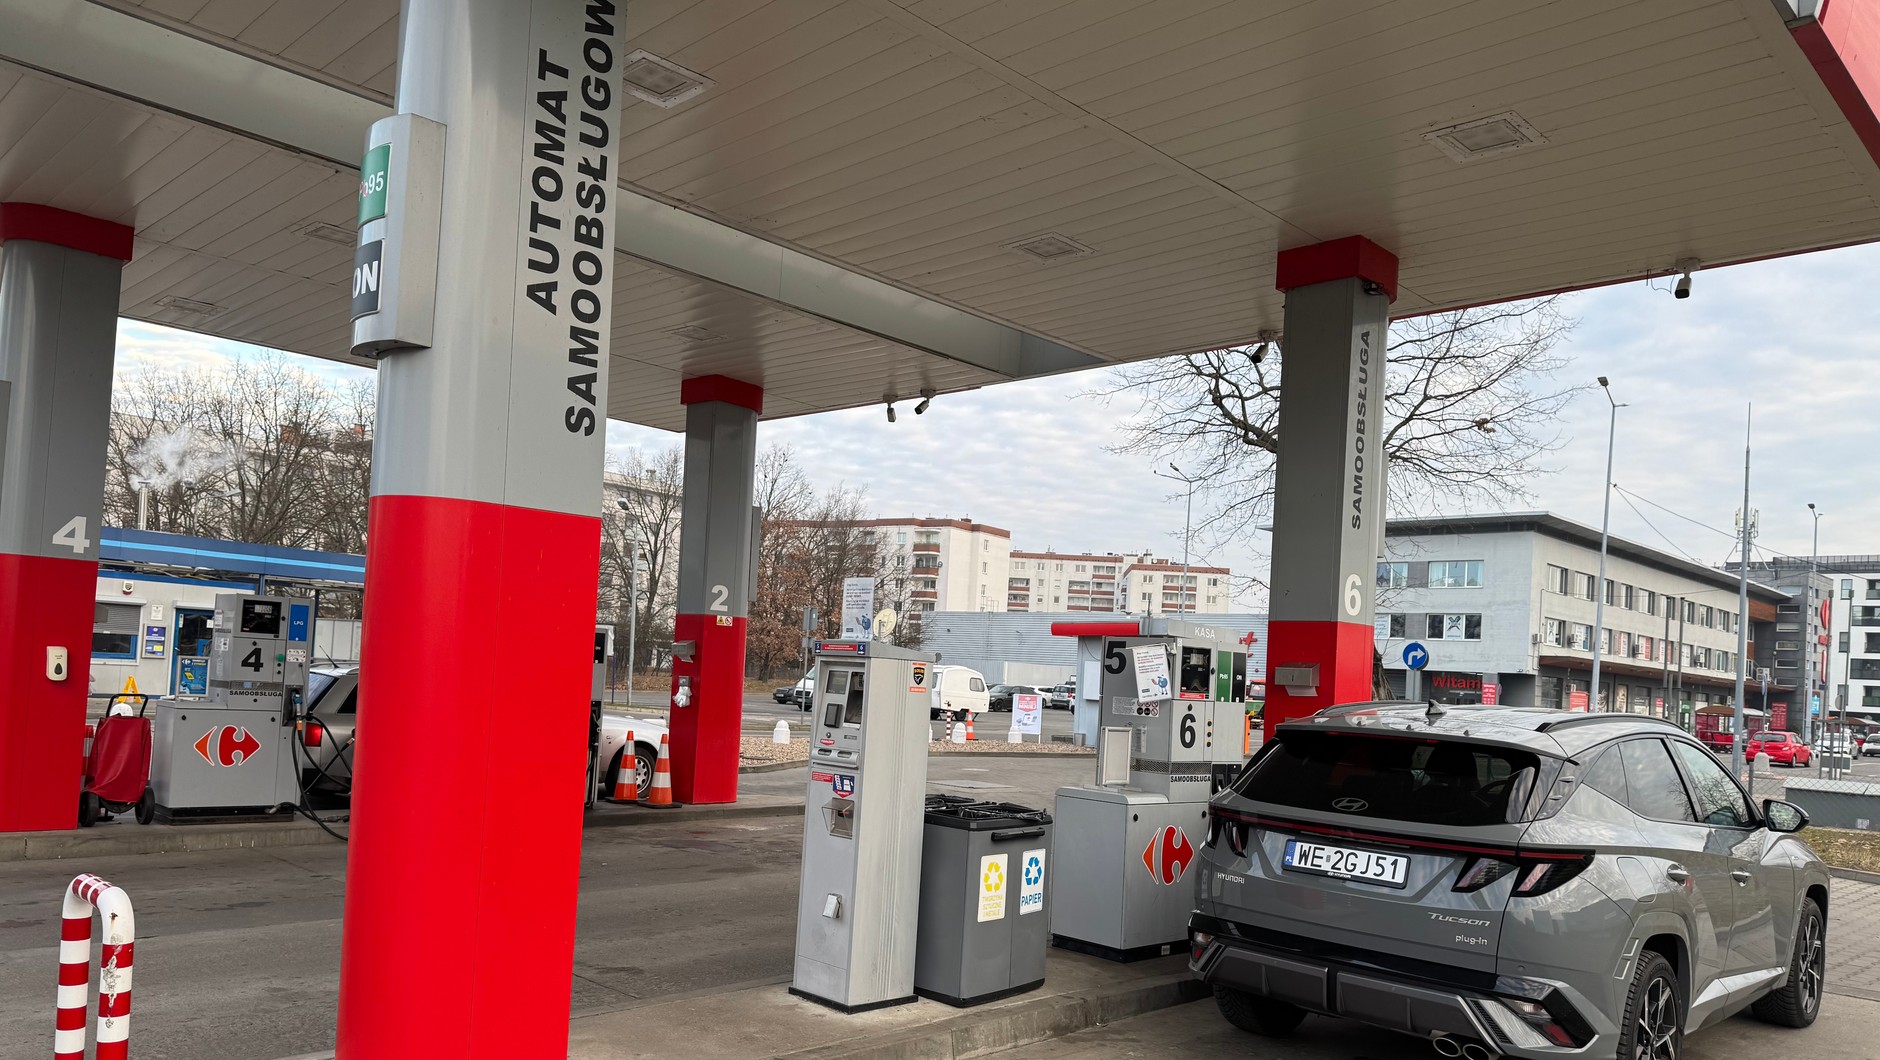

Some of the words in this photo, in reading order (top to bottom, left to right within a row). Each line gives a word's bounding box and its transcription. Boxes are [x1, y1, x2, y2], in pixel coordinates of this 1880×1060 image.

[526, 48, 569, 315] AUTOMAT
[352, 260, 379, 299] ON
[1352, 329, 1371, 530] SAMOOBSŁUGA
[52, 515, 90, 554] 4
[710, 584, 729, 612] 2
[1344, 573, 1362, 617] 6
[1194, 626, 1216, 640] KASA
[241, 647, 264, 672] 4
[1104, 640, 1127, 674] 5
[1180, 713, 1196, 749] 6
[1170, 775, 1211, 783] SAMOOBSŁUGA
[1217, 872, 1245, 884] HYUNDAI
[1298, 844, 1326, 868] WE
[1330, 849, 1400, 880] 2GJ51
[1021, 892, 1042, 907] PAPIER
[1455, 934, 1488, 946] plug-in
